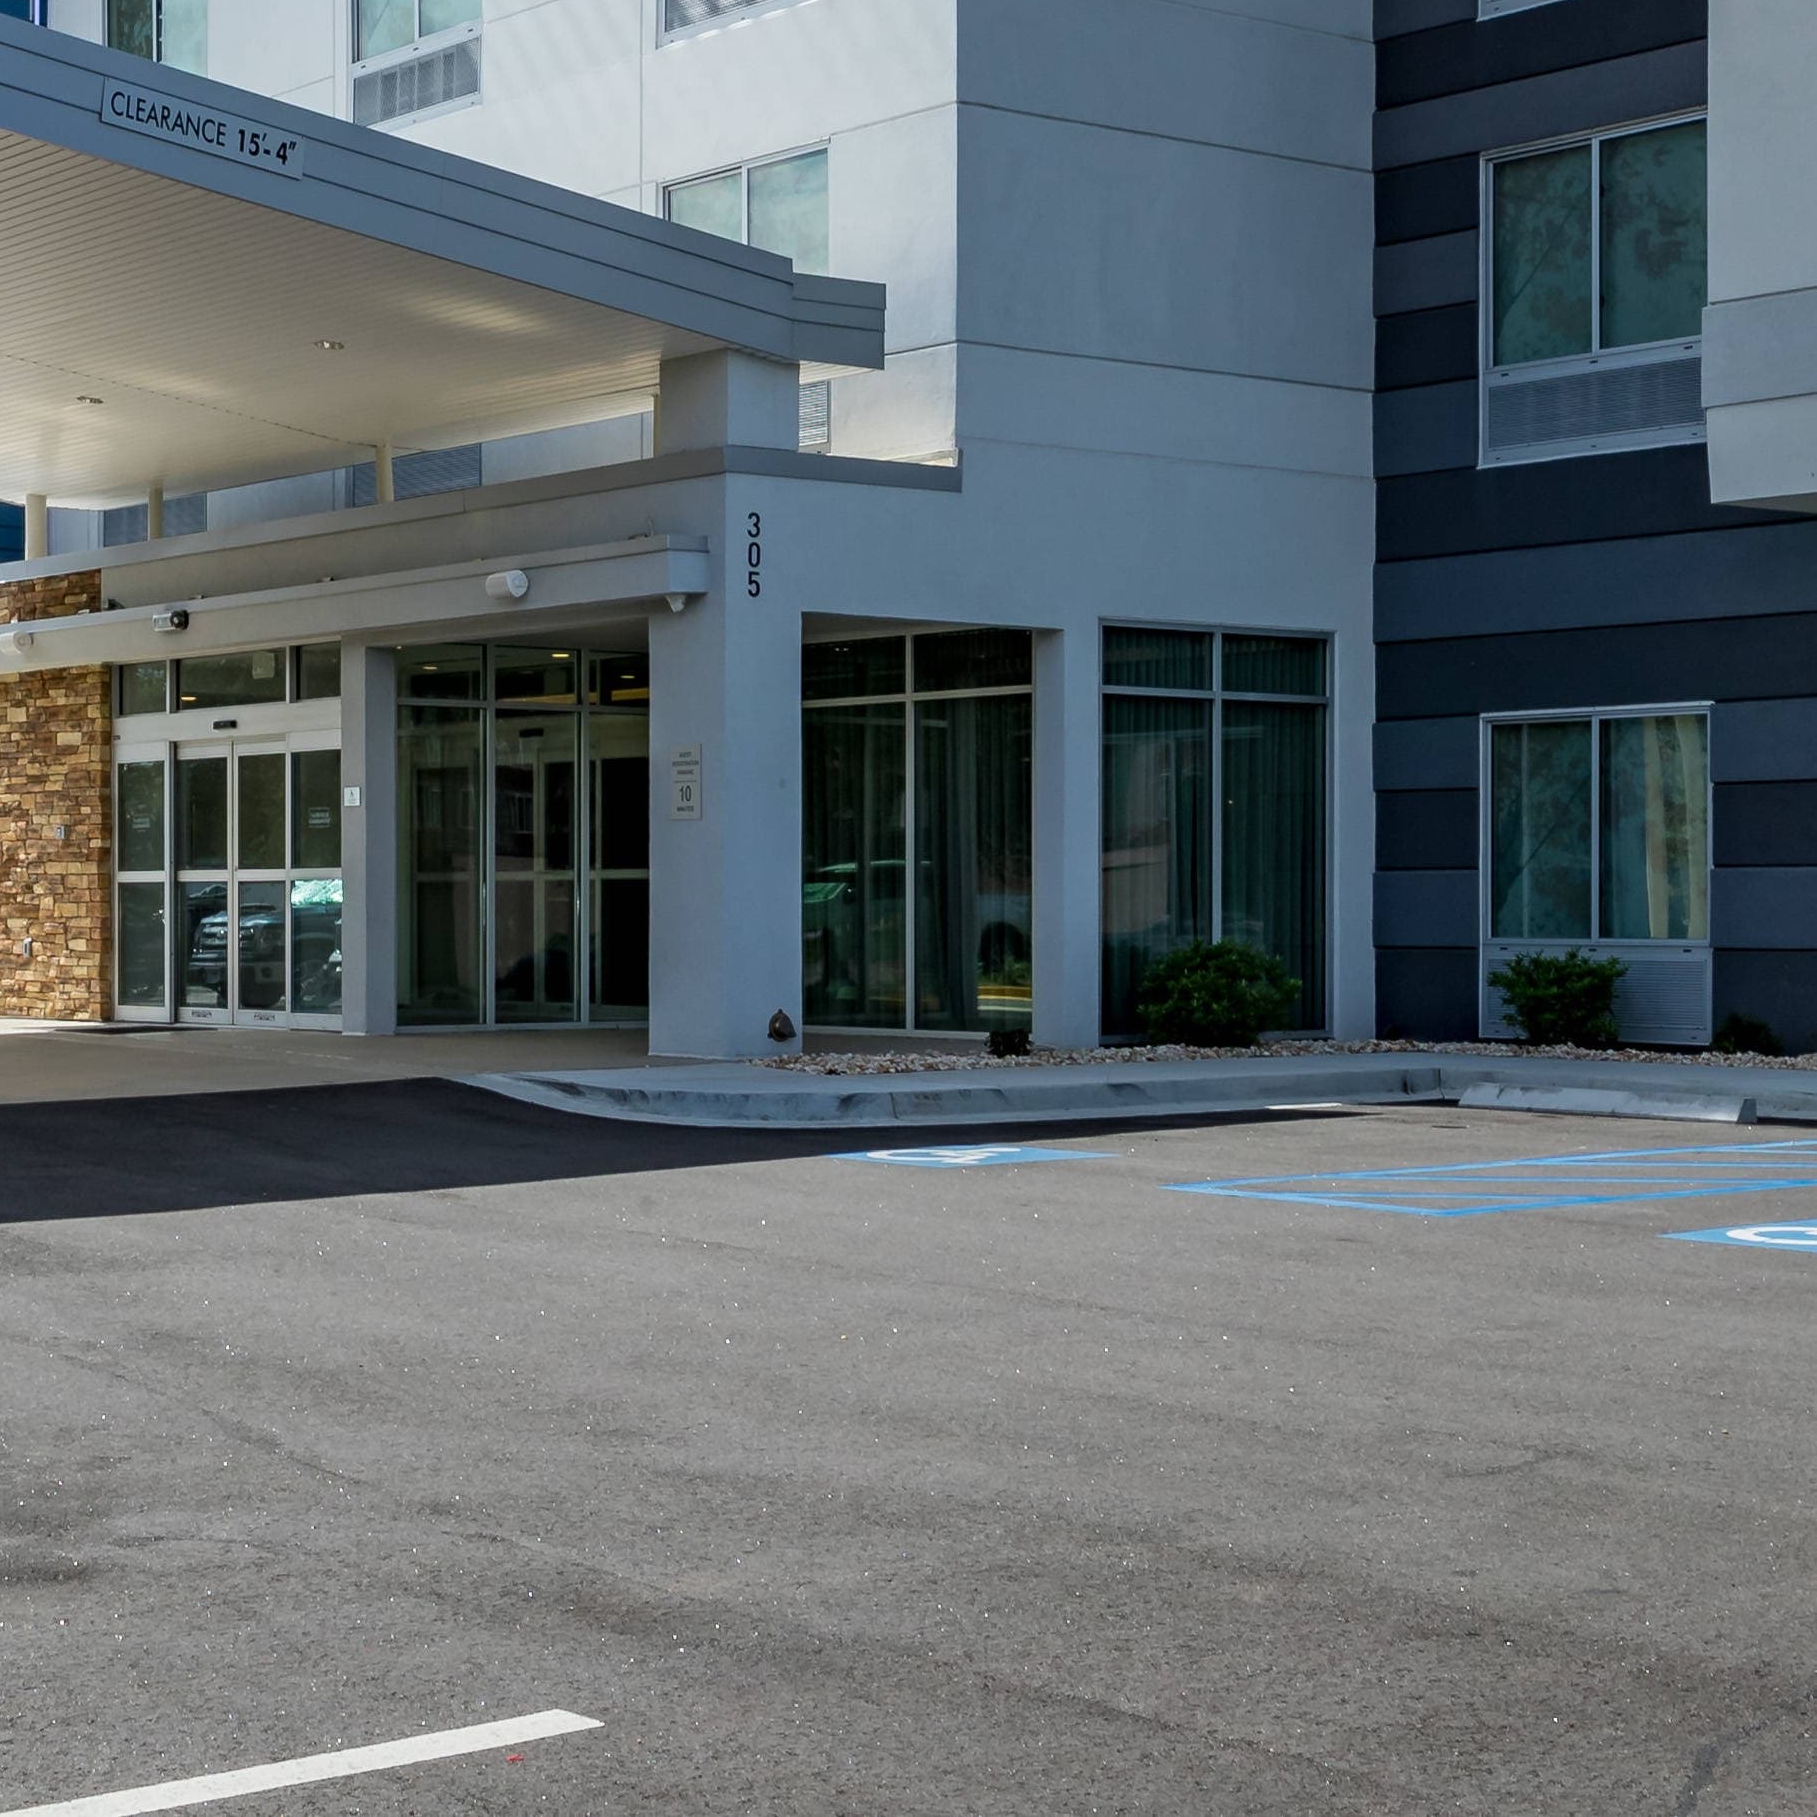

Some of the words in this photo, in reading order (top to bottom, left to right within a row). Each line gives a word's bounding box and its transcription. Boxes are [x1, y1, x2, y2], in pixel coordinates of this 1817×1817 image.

[110, 90, 227, 147] CLEARANCE
[747, 511, 761, 598] 305
[678, 784, 692, 803] 10
